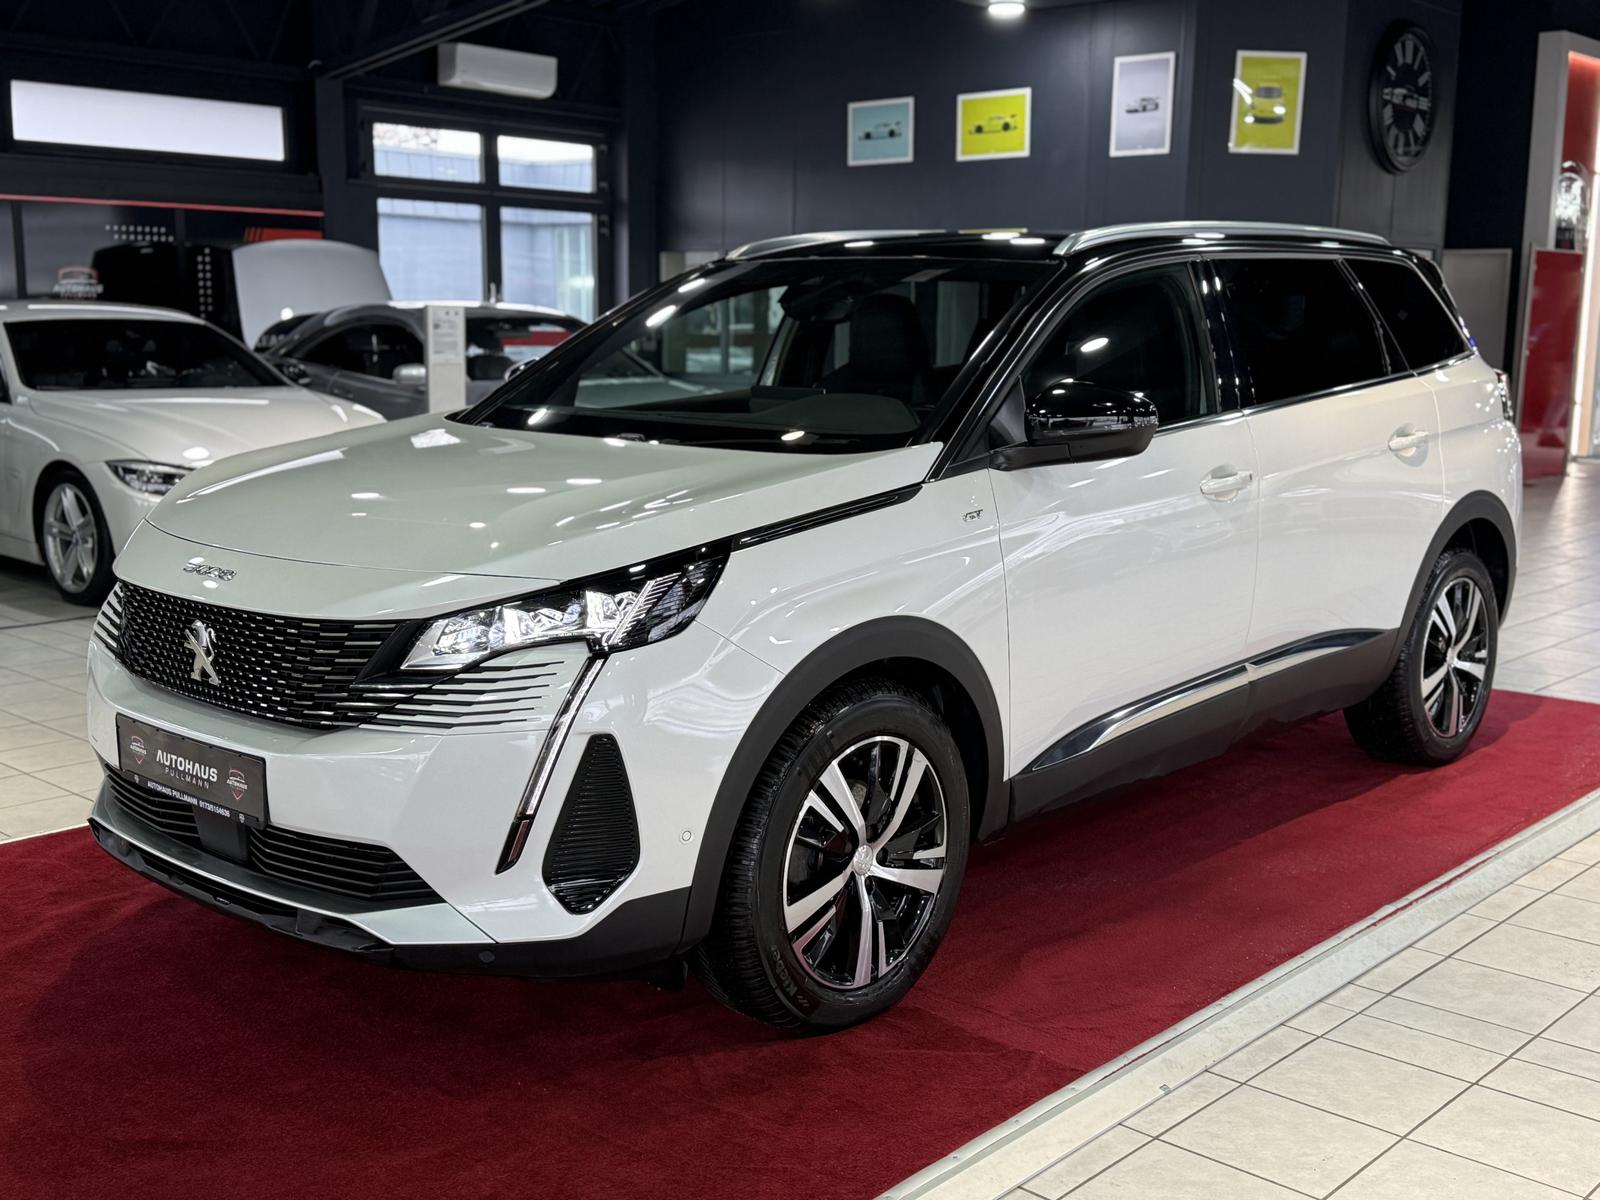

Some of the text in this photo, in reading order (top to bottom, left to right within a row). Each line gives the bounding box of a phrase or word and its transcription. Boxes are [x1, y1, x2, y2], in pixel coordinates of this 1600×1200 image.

[156, 749, 218, 782] AUTOHAUS
[165, 767, 210, 789] PULLMANN
[147, 780, 172, 796] AUTOHAUS
[172, 788, 198, 806] PULLMANN
